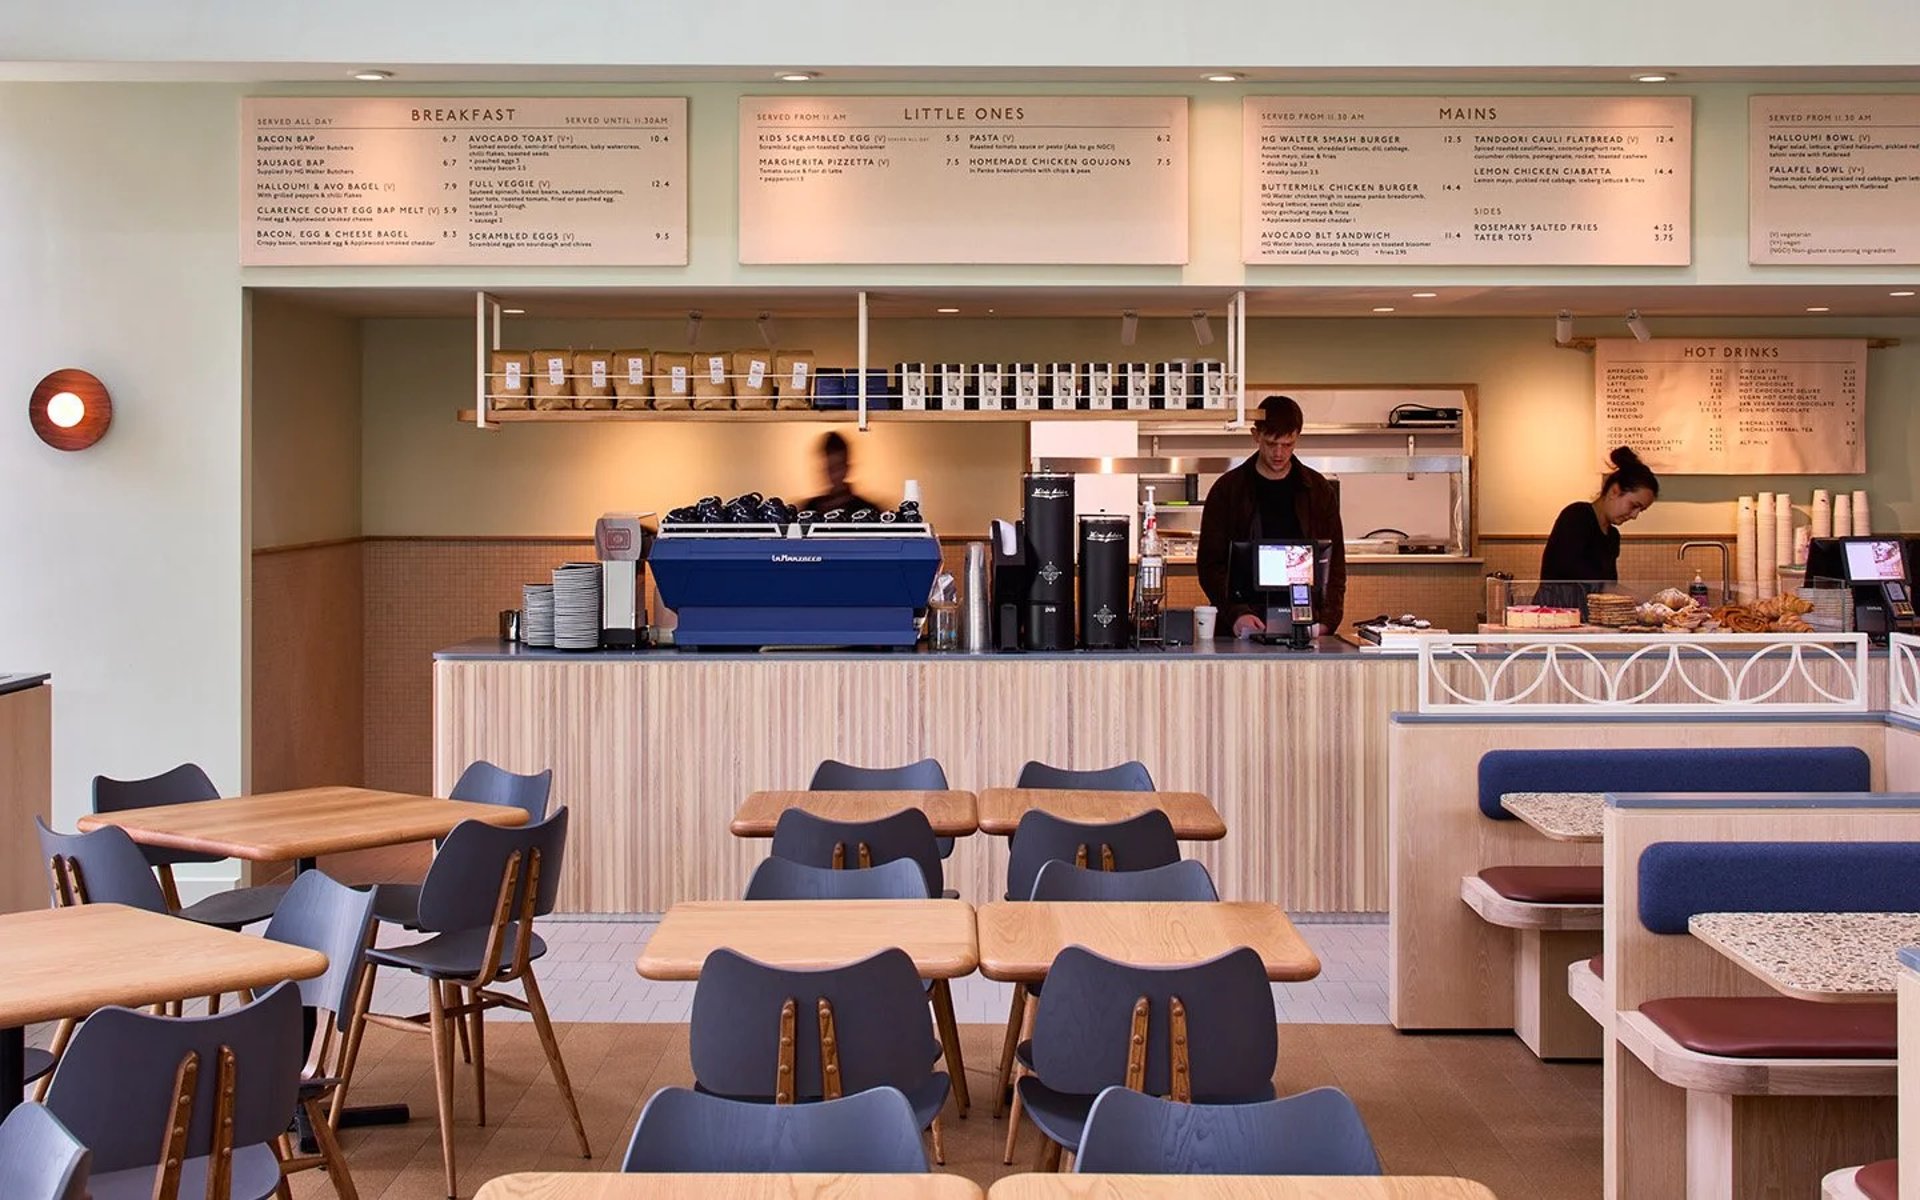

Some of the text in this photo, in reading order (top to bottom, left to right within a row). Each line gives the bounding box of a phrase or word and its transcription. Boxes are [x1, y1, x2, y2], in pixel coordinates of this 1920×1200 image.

[412, 109, 515, 121] BREAKFAST
[794, 112, 819, 120] FROM
[905, 108, 1024, 120] LITTLE ONES
[1440, 108, 1496, 120] MAINS
[297, 135, 315, 143] BAP
[557, 135, 573, 143] (V+)
[874, 135, 886, 143] (V)
[946, 134, 959, 142] 5.5
[1002, 134, 1014, 143] (V)
[1262, 135, 1275, 143] HG
[1627, 136, 1639, 145] (V)
[878, 159, 889, 167] (V)
[1081, 158, 1131, 166] GOUJONS
[1157, 158, 1171, 166] 7.5
[1848, 166, 1865, 174] (V+)
[384, 183, 395, 192] (V)
[469, 180, 493, 188] FULL
[539, 180, 550, 189] (V)
[428, 207, 440, 215] (V)
[563, 233, 574, 241] (V)
[1508, 233, 1532, 241] TOTS
[1684, 347, 1778, 357] HOT DRINKS
